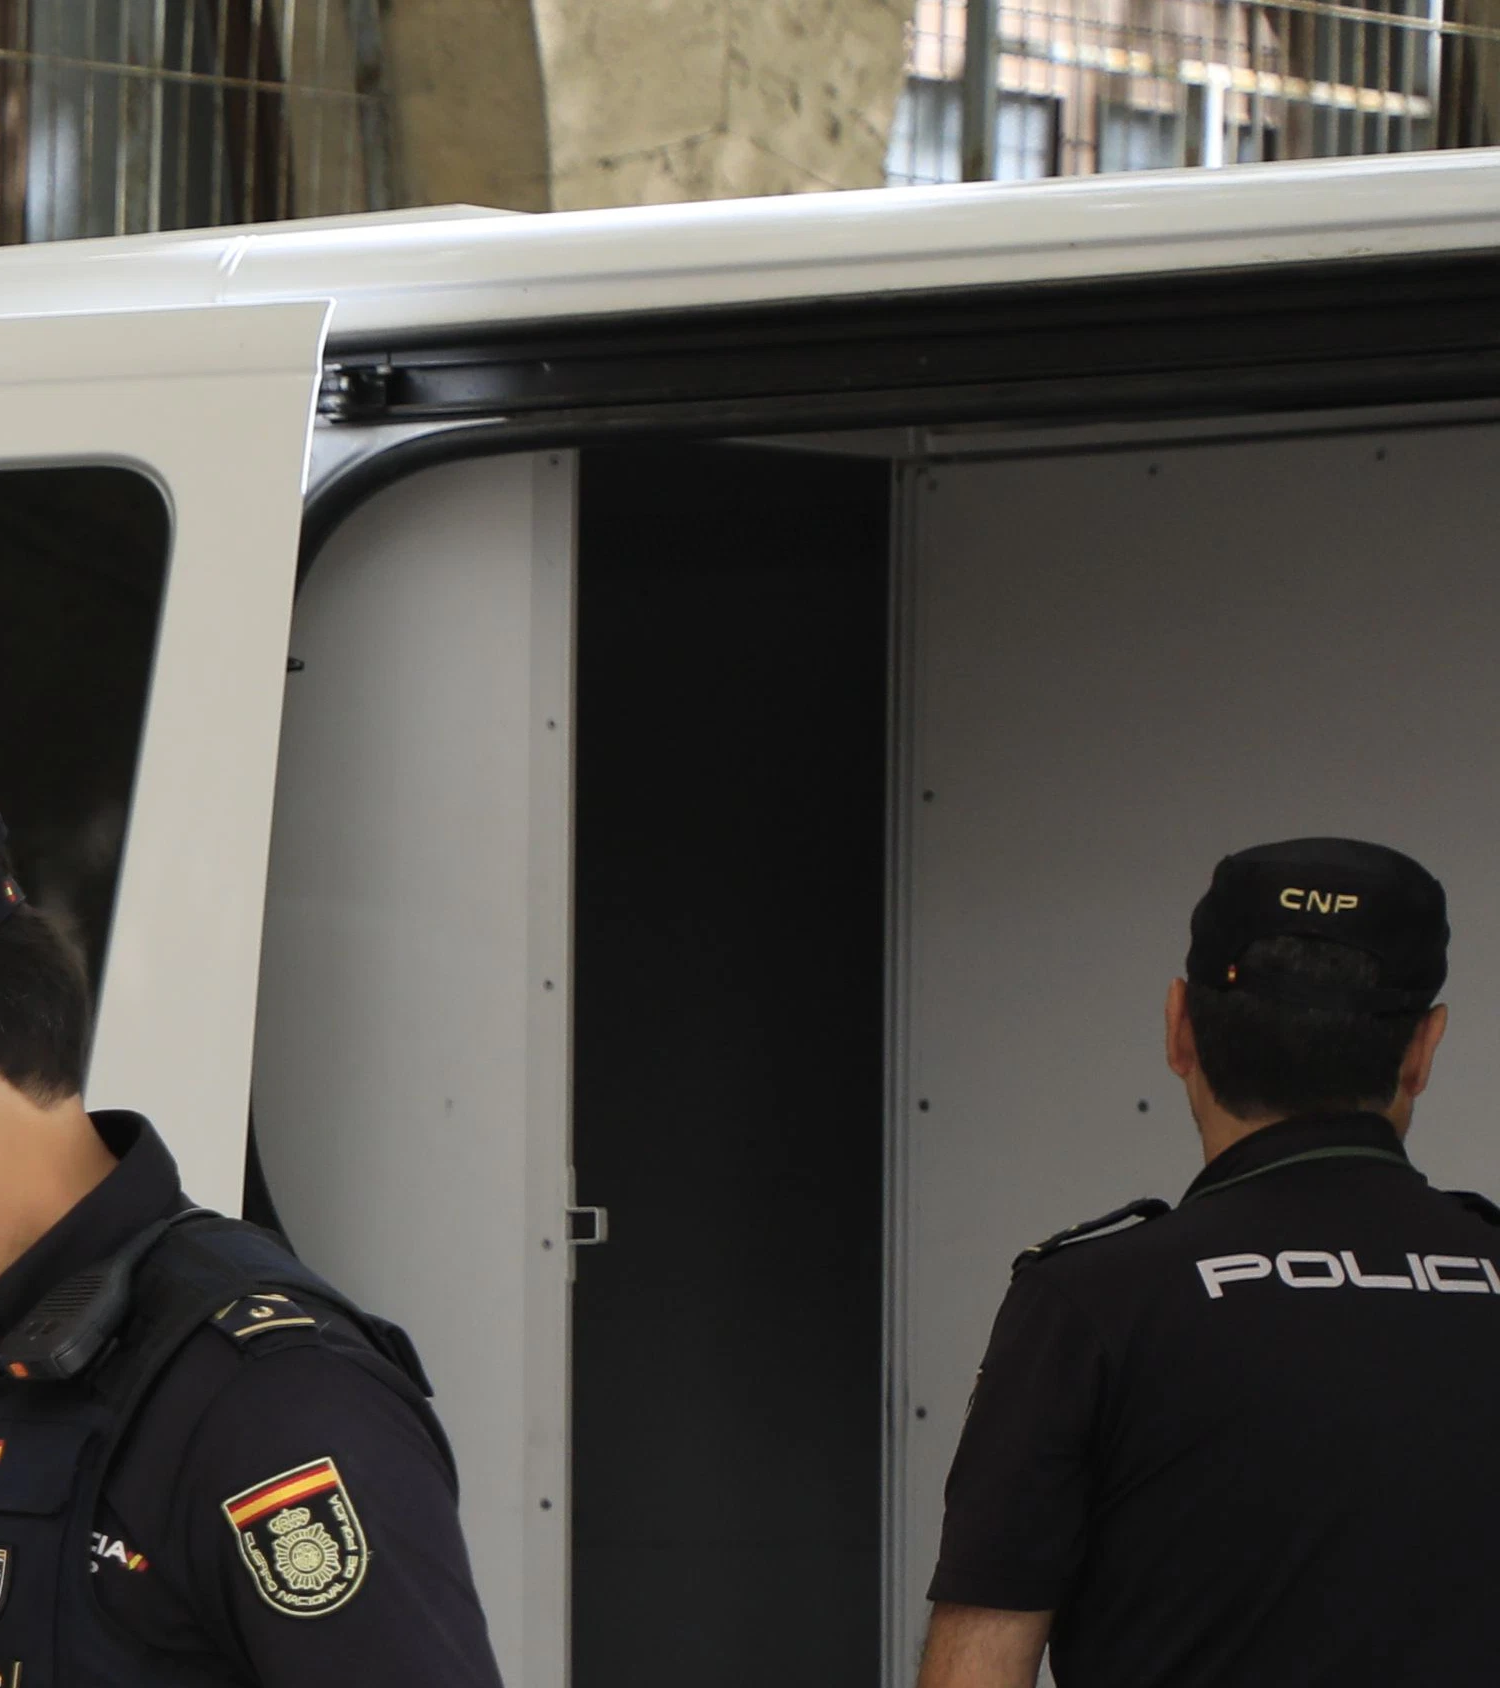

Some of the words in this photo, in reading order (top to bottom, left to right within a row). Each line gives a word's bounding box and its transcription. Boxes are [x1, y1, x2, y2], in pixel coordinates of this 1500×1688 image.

[1280, 888, 1358, 914] CNP
[328, 1494, 359, 1550] POLICIA
[244, 1531, 278, 1592] CUERPO
[343, 1555, 359, 1578] DE
[276, 1582, 347, 1606] NACIONAL
